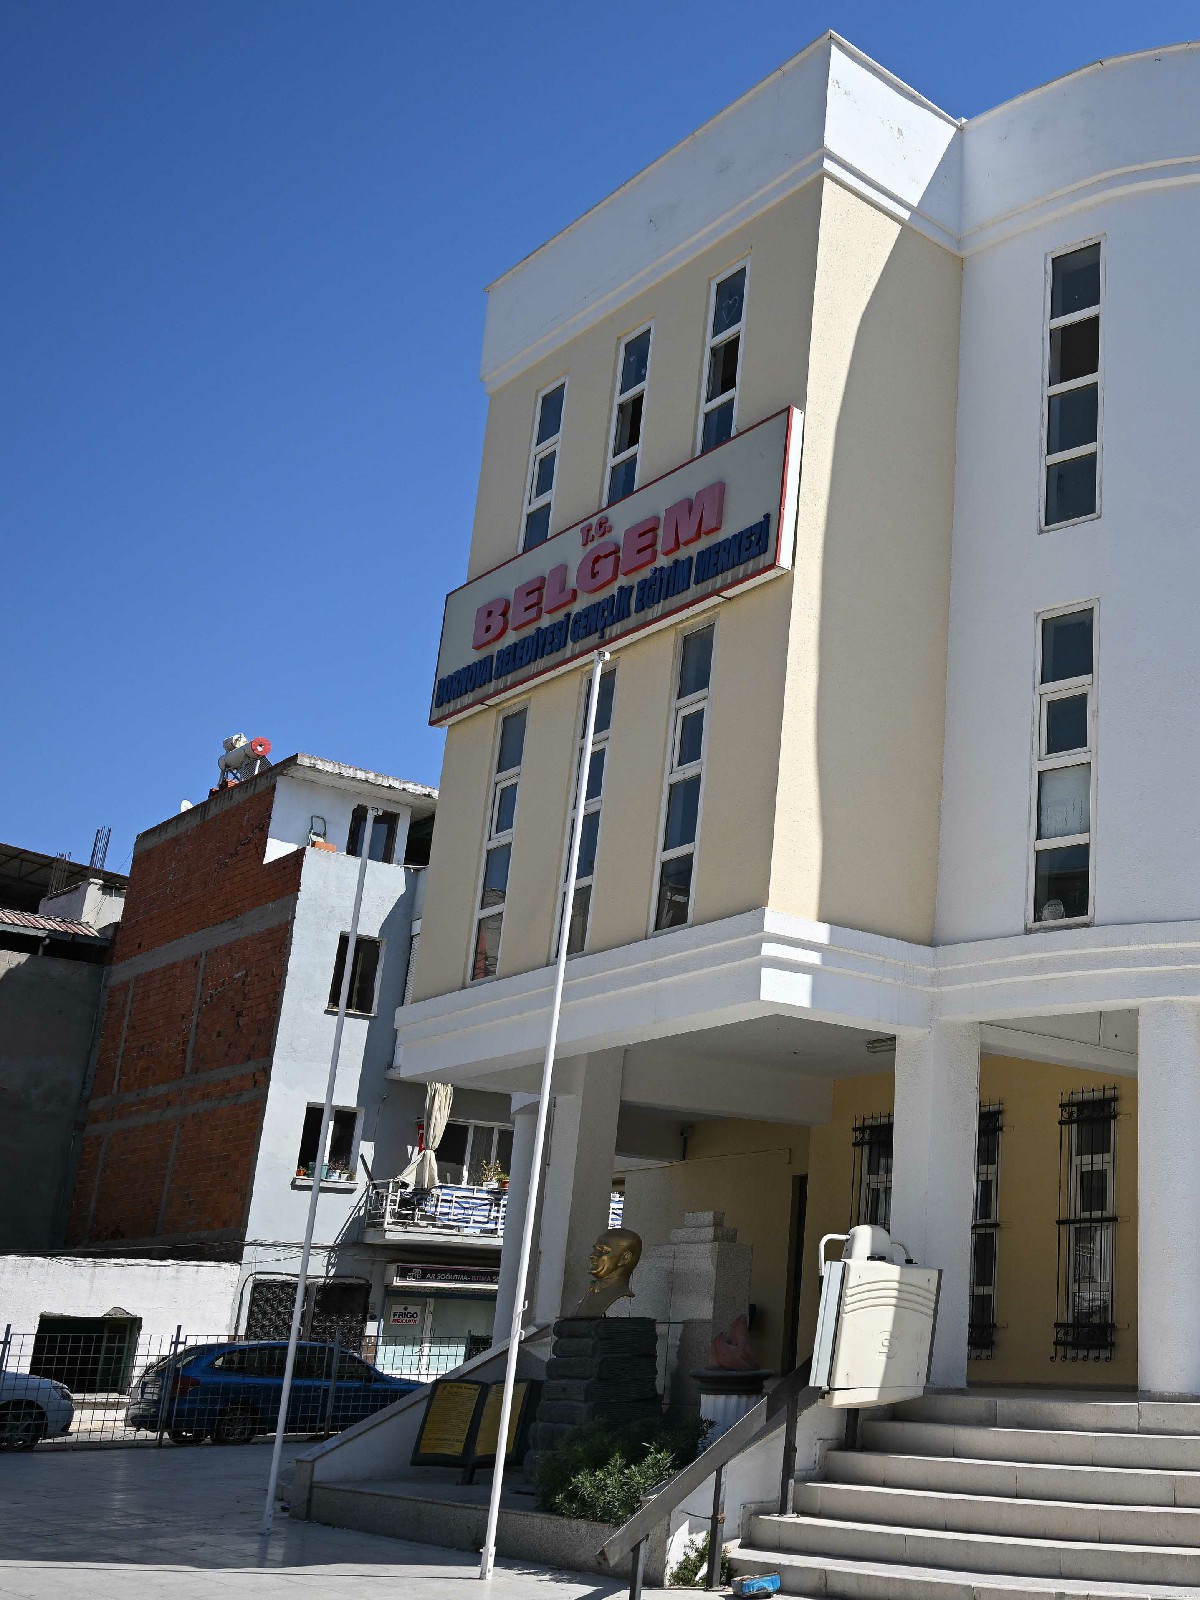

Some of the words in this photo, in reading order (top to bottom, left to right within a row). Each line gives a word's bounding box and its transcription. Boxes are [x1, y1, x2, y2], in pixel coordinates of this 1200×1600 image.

[472, 481, 725, 650] BELGEM
[580, 516, 612, 546] T.C.
[634, 556, 693, 614] EĞİTİM
[693, 512, 771, 585] MERKEZİ
